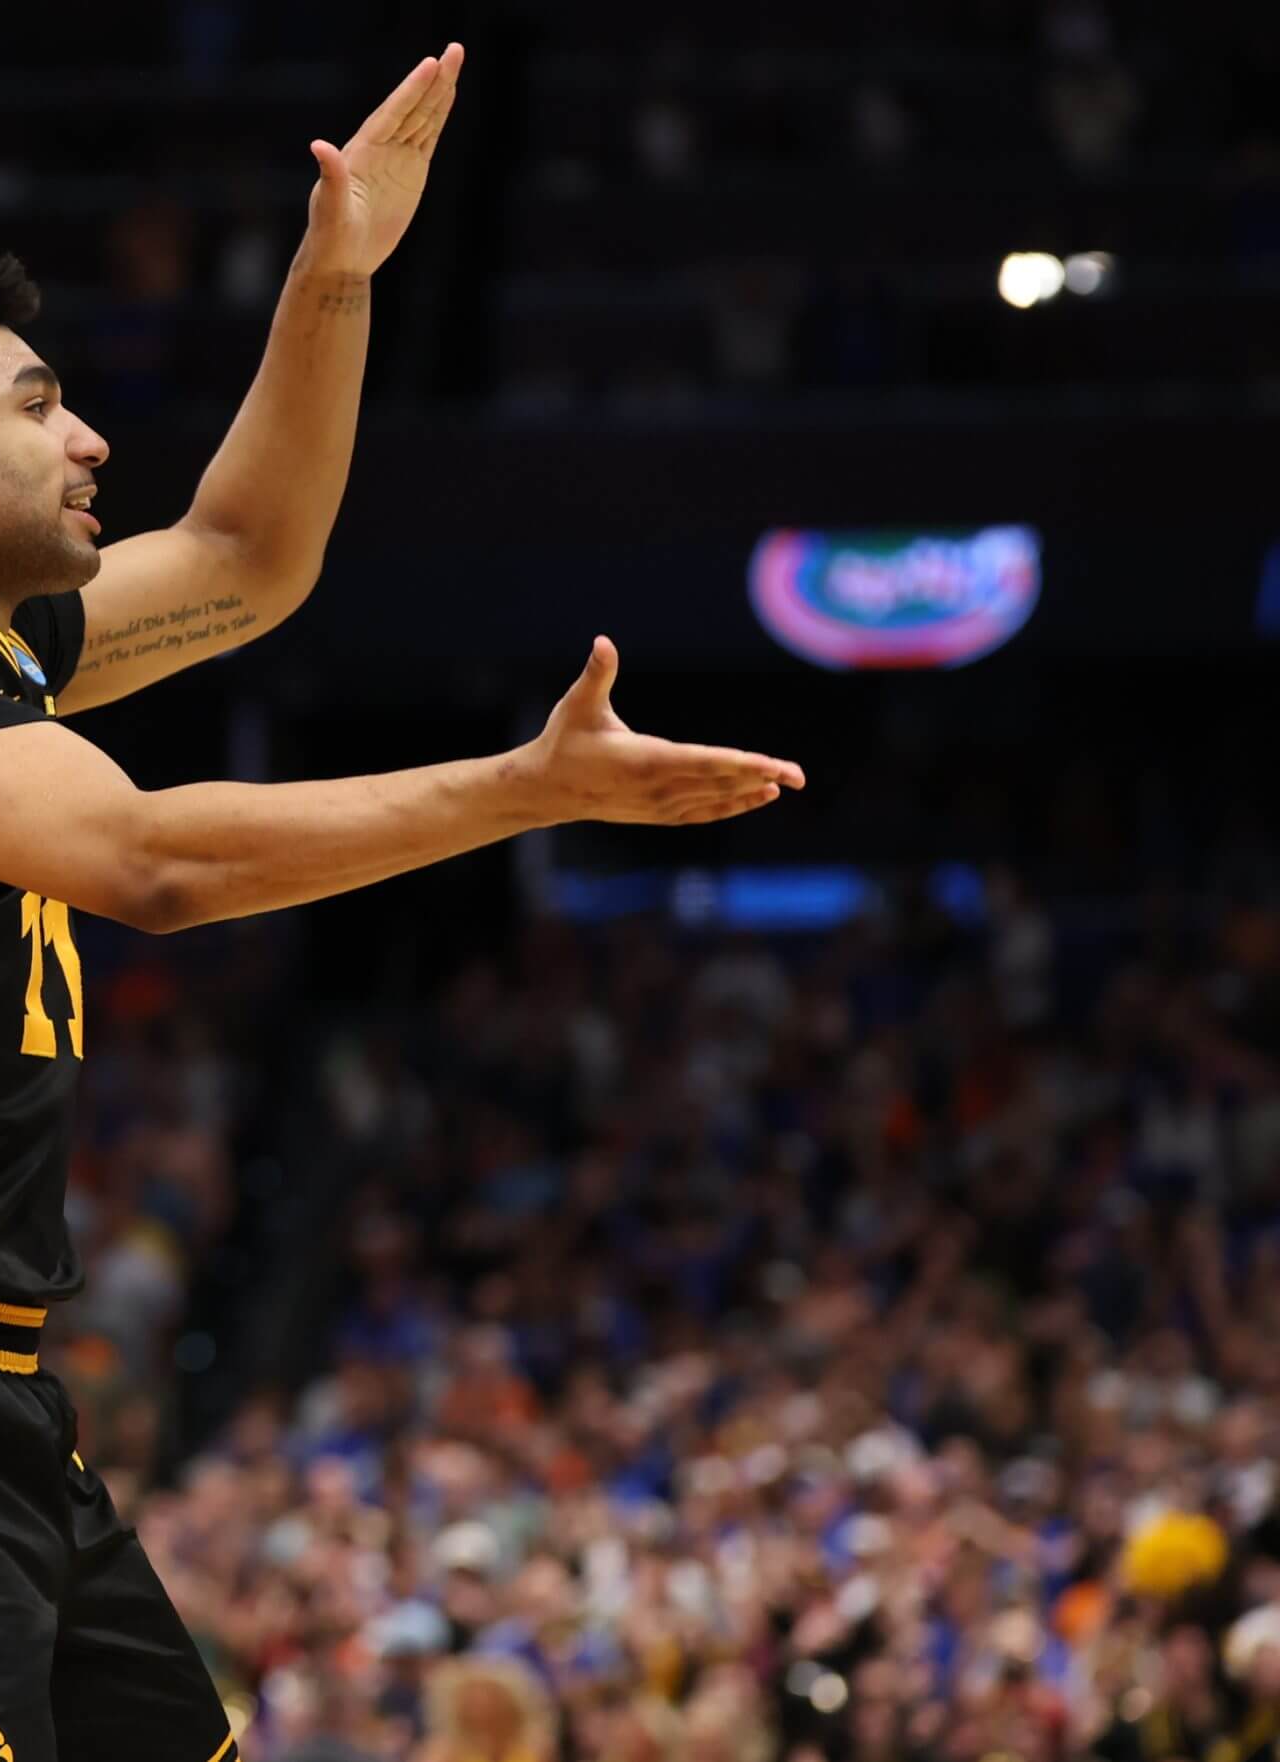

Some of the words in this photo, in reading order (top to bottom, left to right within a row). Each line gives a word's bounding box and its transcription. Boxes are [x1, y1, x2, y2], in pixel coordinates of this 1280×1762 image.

[97, 616, 141, 648] Should
[143, 614, 166, 632] Die
[168, 602, 202, 627] Before
[105, 647, 130, 664] The
[134, 634, 164, 656] Lord
[165, 632, 183, 649] My
[186, 623, 211, 643] Soul
[213, 621, 228, 636] To
[230, 611, 258, 632] Take
